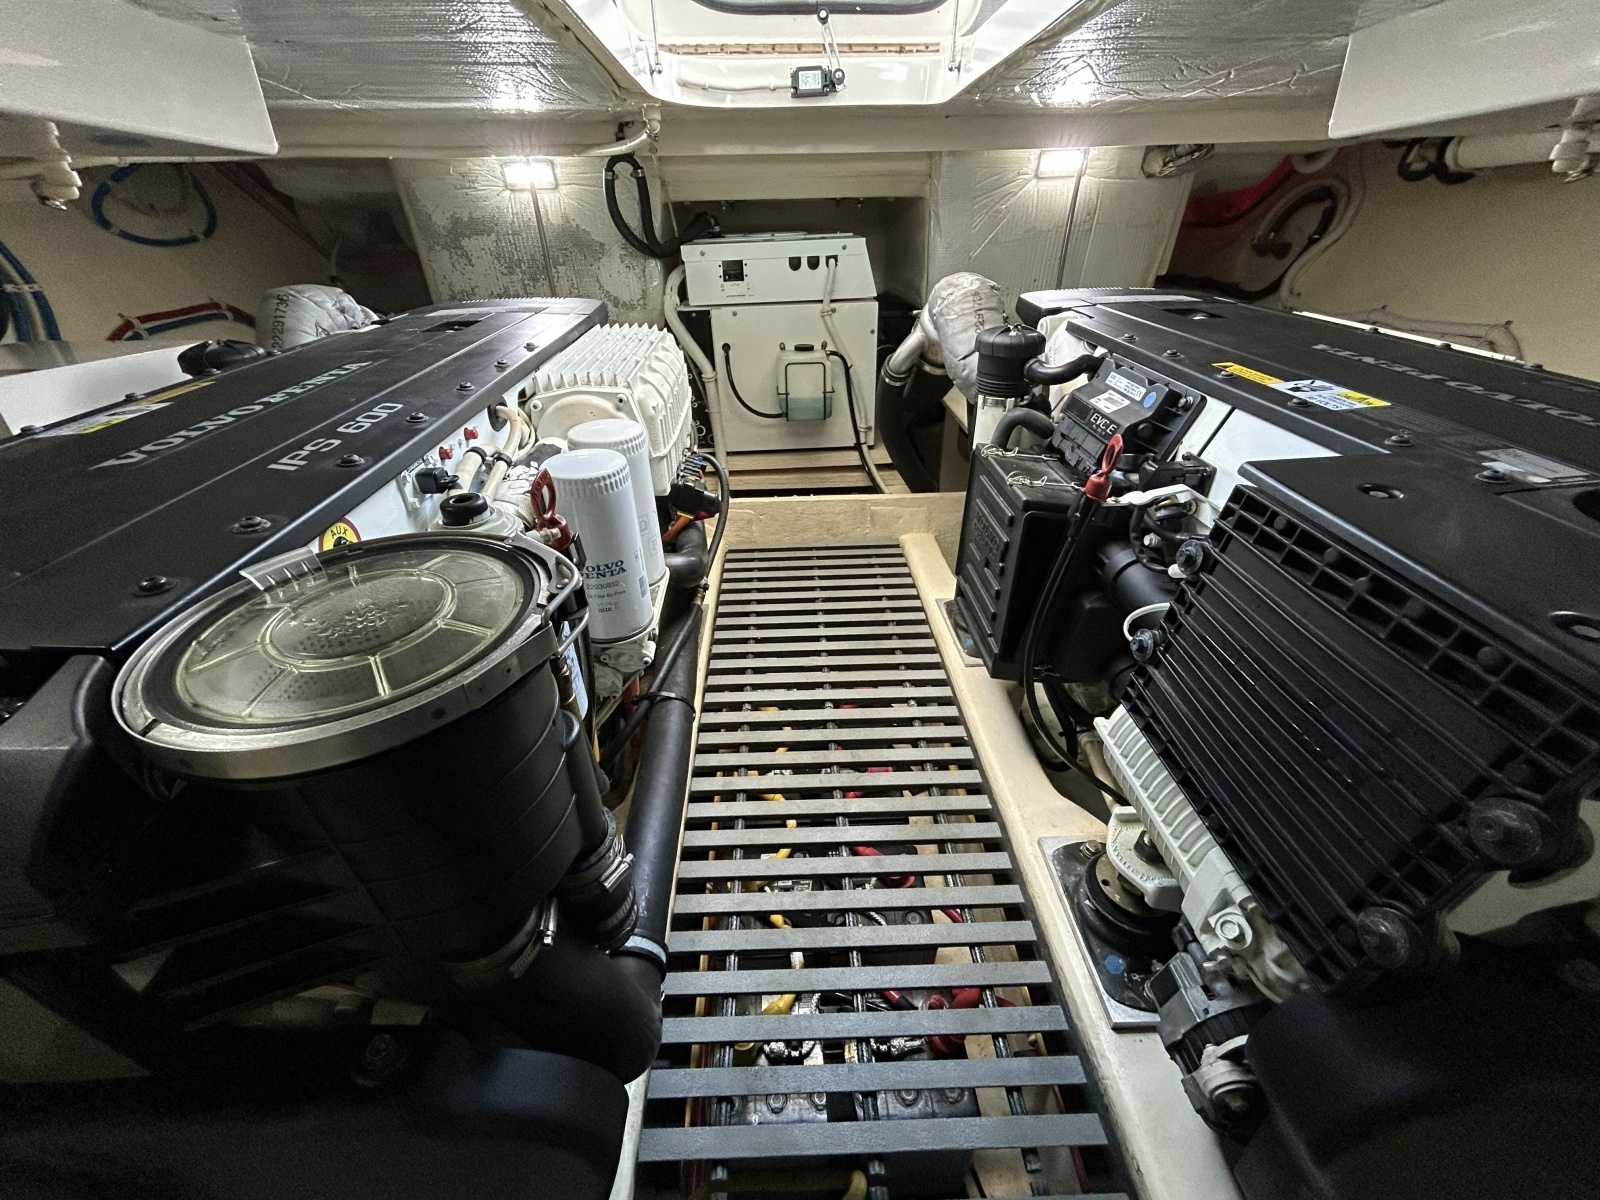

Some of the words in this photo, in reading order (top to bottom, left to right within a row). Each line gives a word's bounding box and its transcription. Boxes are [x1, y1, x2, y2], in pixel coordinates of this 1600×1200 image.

[271, 293, 290, 349] 22291736
[88, 405, 264, 470] VOLVO
[254, 361, 373, 403] PENTA
[1090, 413, 1110, 429] EVC
[1106, 424, 1118, 435] E
[267, 438, 342, 471] IPS
[336, 403, 403, 433] 600
[330, 525, 348, 540] AUX
[580, 560, 624, 573] OLVO
